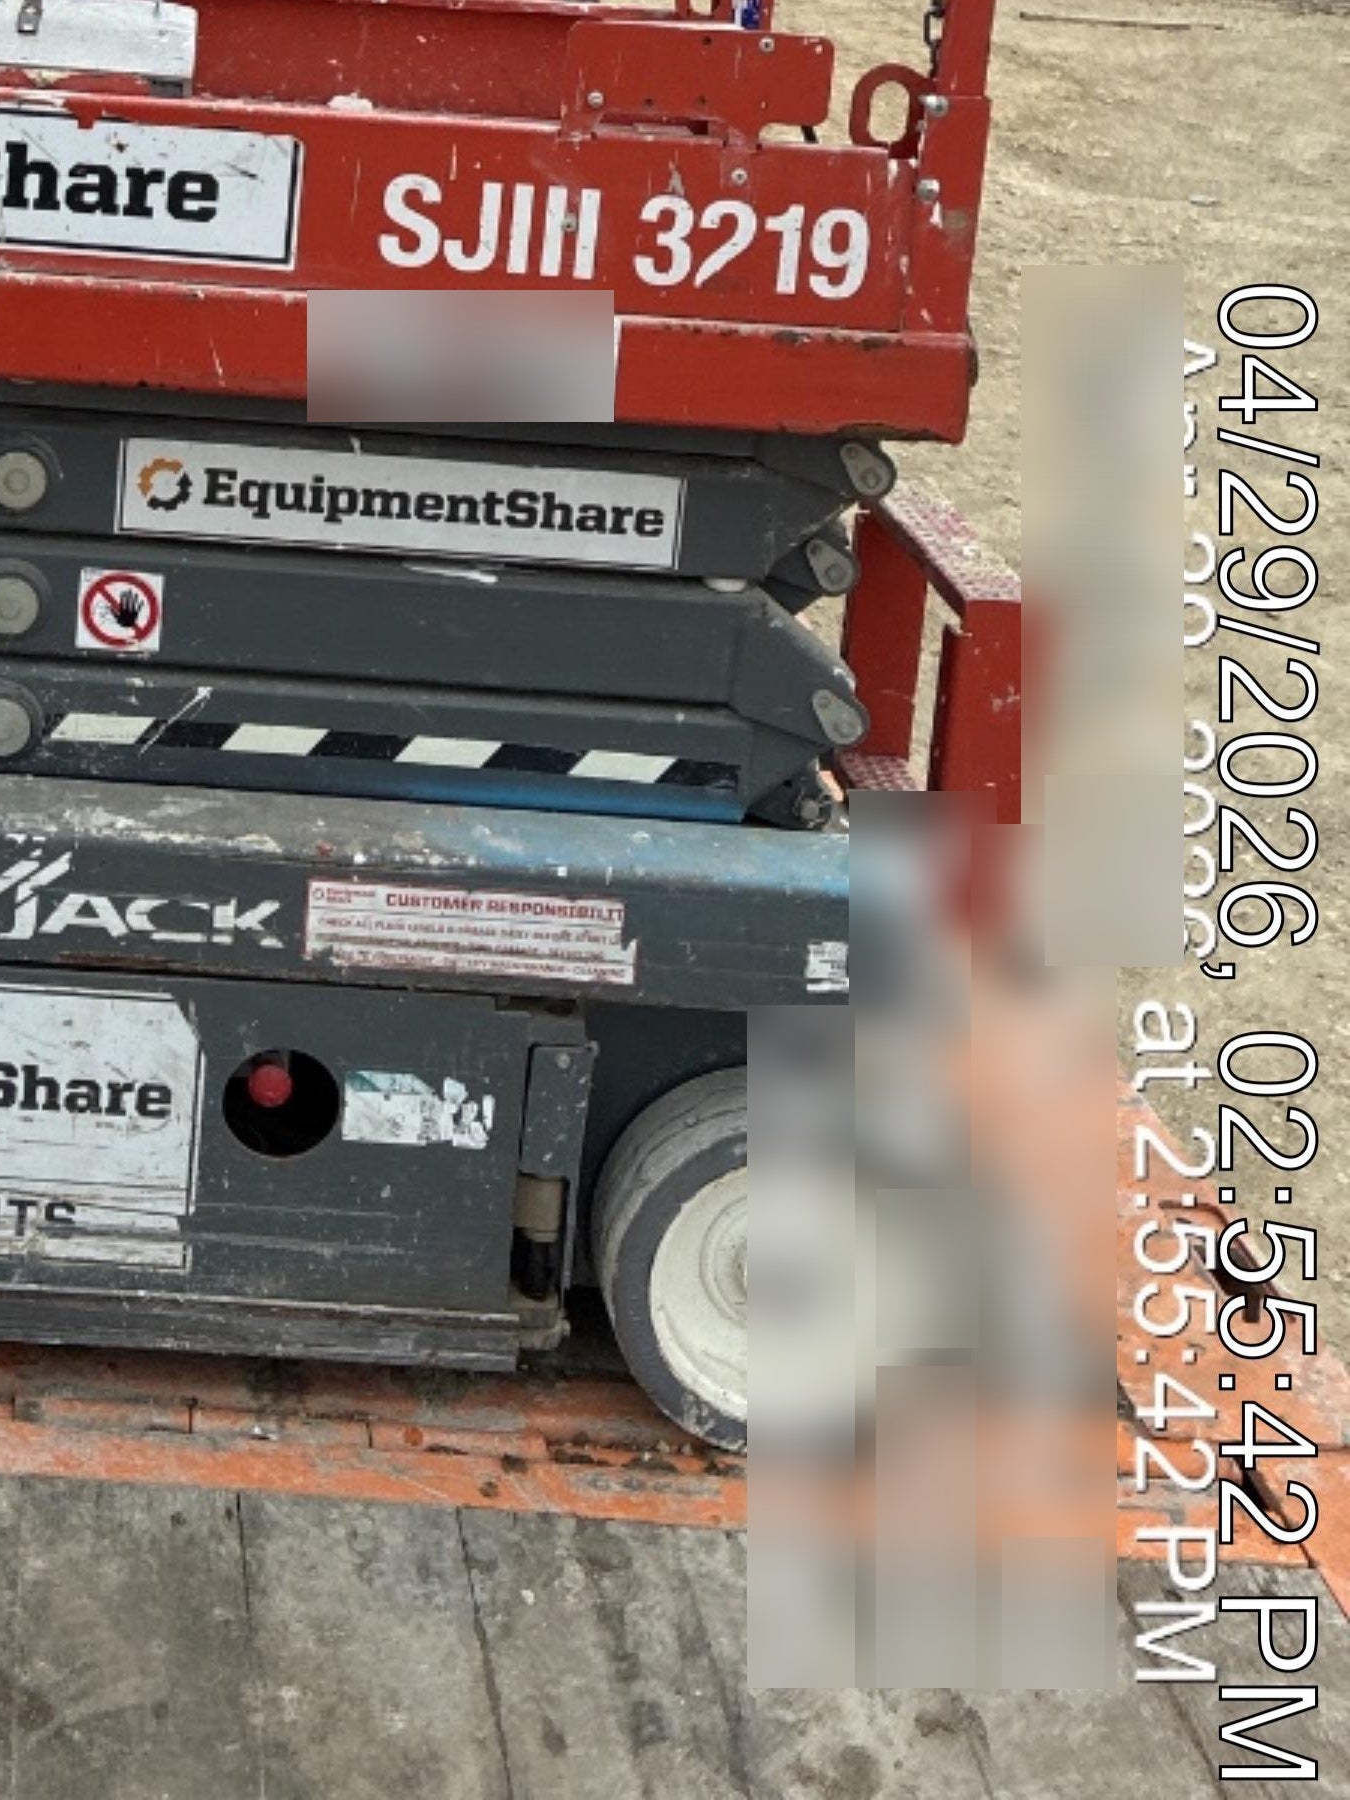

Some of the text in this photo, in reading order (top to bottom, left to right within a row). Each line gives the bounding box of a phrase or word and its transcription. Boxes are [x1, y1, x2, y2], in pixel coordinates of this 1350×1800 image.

[378, 173, 869, 300] SJIII 3219
[203, 467, 665, 539] EquipmentShare
[385, 891, 482, 914] CUSTOMER
[485, 898, 625, 922] RESPONSIBILIT
